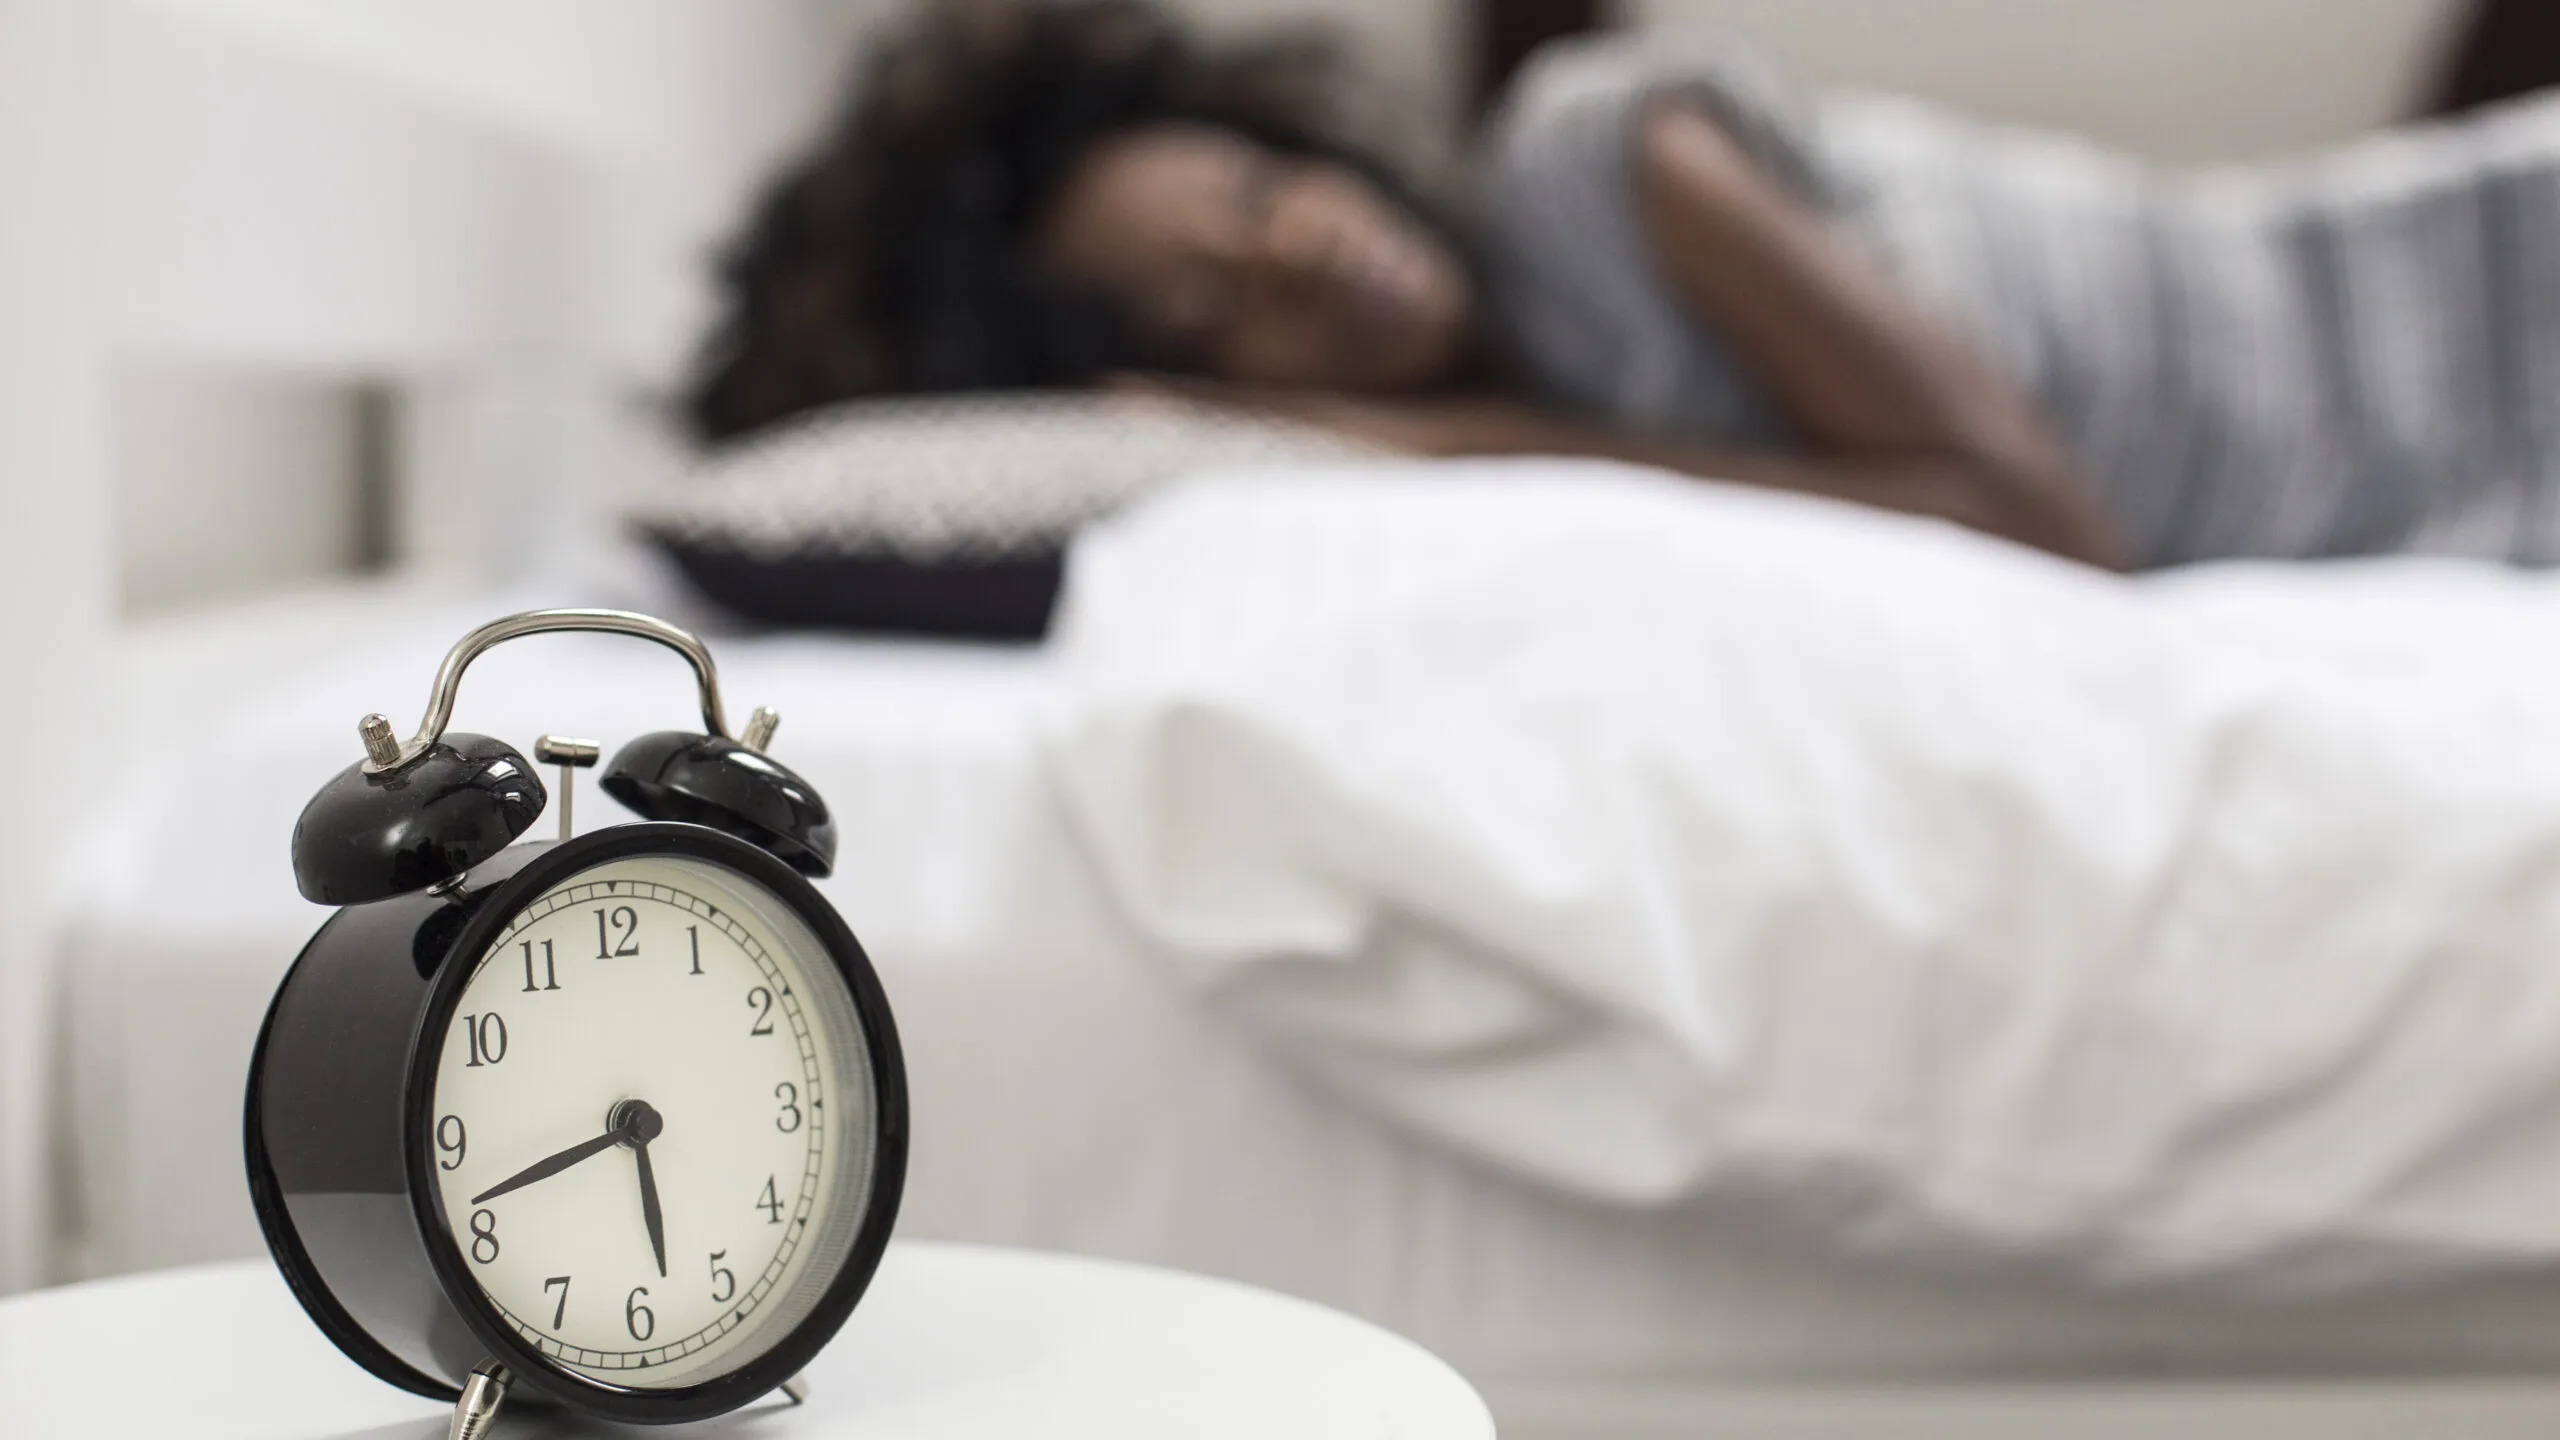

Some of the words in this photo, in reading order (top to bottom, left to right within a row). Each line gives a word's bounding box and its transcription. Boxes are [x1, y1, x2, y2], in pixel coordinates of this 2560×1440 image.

[594, 906, 638, 959] 12
[686, 925, 704, 975] 1
[519, 939, 560, 992] 11
[748, 987, 773, 1036] 2
[464, 1012, 507, 1067] 10
[775, 1082, 801, 1132] 3
[437, 1115, 466, 1170] 9
[756, 1175, 784, 1224] 4
[470, 1209, 499, 1264] 8
[710, 1249, 735, 1302] 5
[545, 1276, 570, 1330] 7
[626, 1287, 654, 1341] 6
